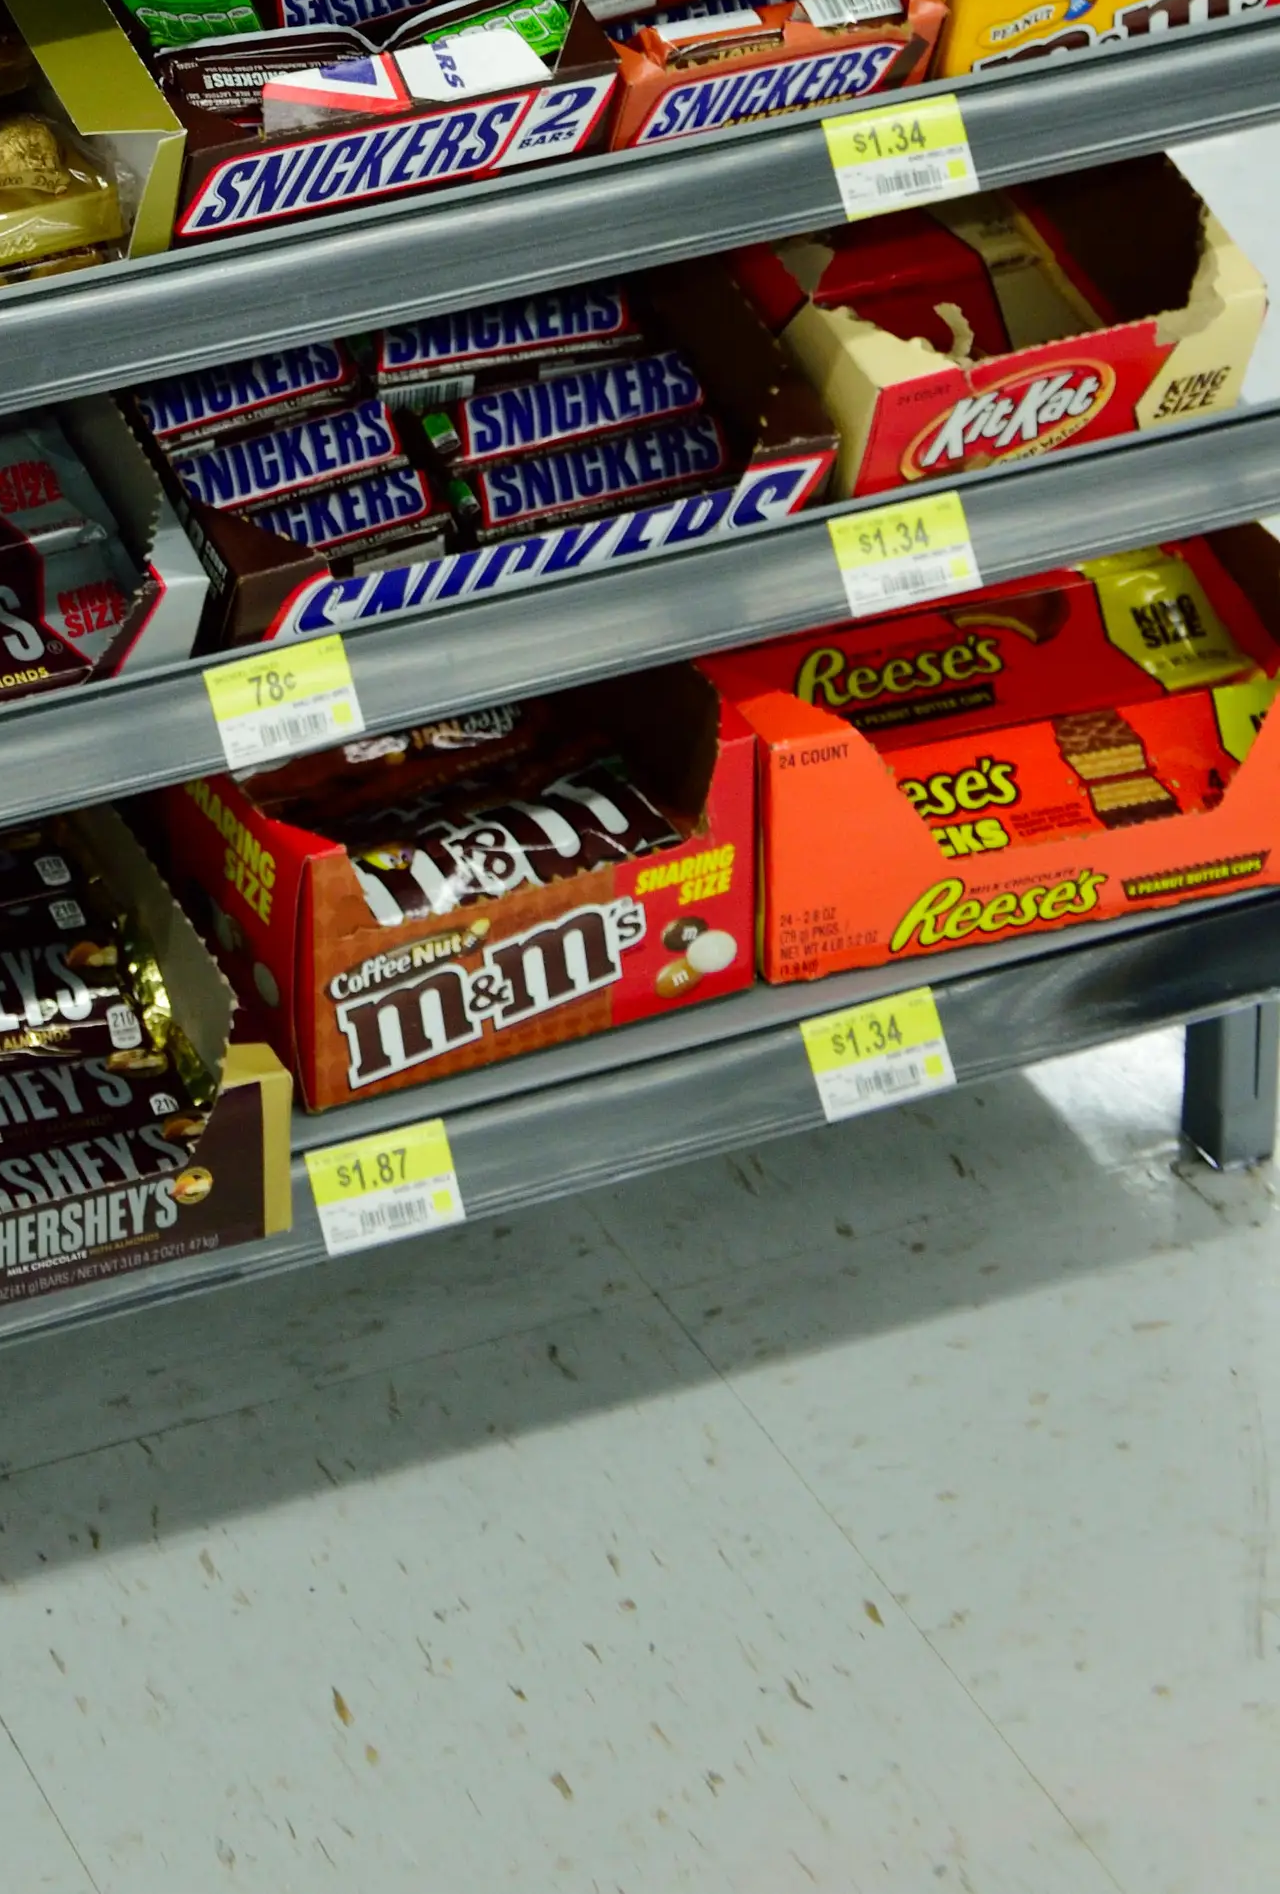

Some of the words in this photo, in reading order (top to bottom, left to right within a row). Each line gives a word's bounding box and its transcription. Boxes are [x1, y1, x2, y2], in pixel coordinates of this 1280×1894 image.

[853, 121, 928, 157] $1.34
[199, 101, 519, 227] SNICKERS
[472, 351, 700, 451] SNICKERS
[1164, 366, 1232, 396] KING
[1154, 390, 1219, 419] SIZE
[490, 416, 722, 518] SNICKERS
[859, 517, 931, 557] $1.34
[247, 669, 299, 707] 78¢
[634, 844, 737, 898] SHARING
[679, 869, 733, 905] SIZE
[830, 1017, 904, 1060] $1.34
[335, 1148, 409, 1191] $1.87
